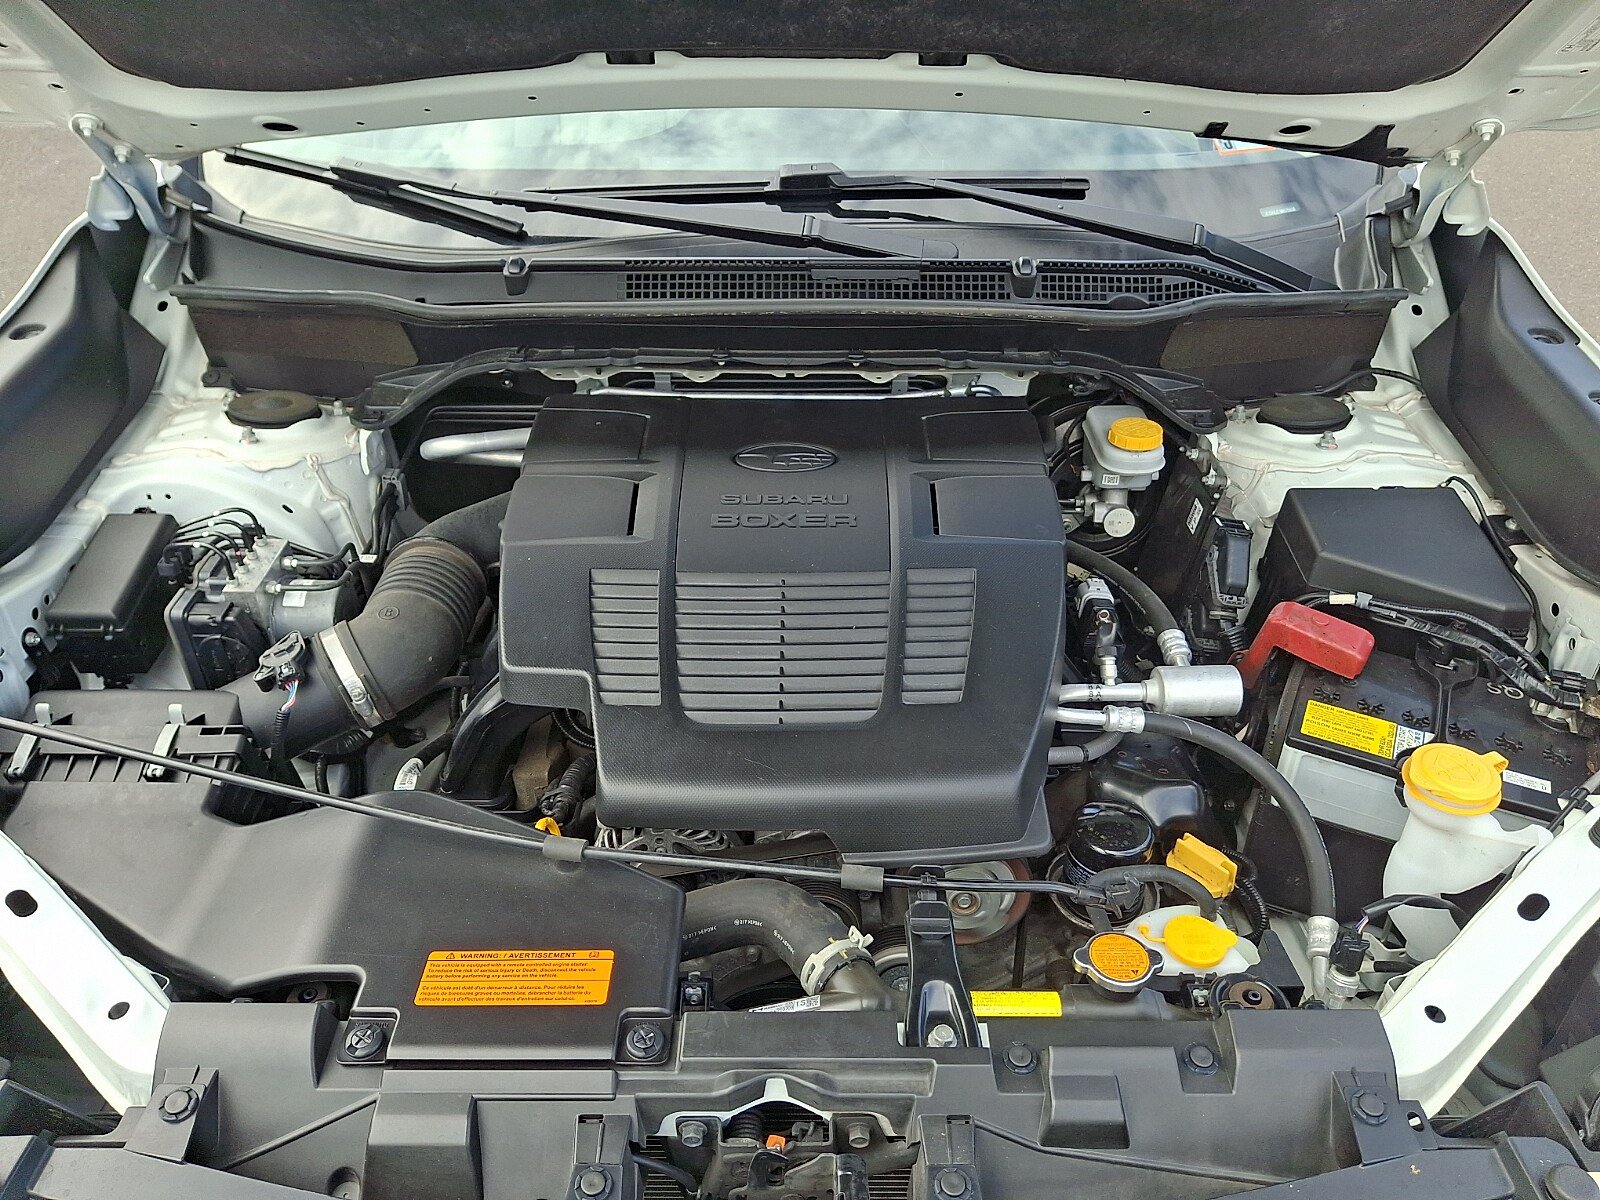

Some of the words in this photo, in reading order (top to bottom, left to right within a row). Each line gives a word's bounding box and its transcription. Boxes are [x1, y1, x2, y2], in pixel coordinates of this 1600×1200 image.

[720, 494, 849, 506] SUBARU
[711, 513, 857, 528] BOXER
[1306, 719, 1330, 728] POISON
